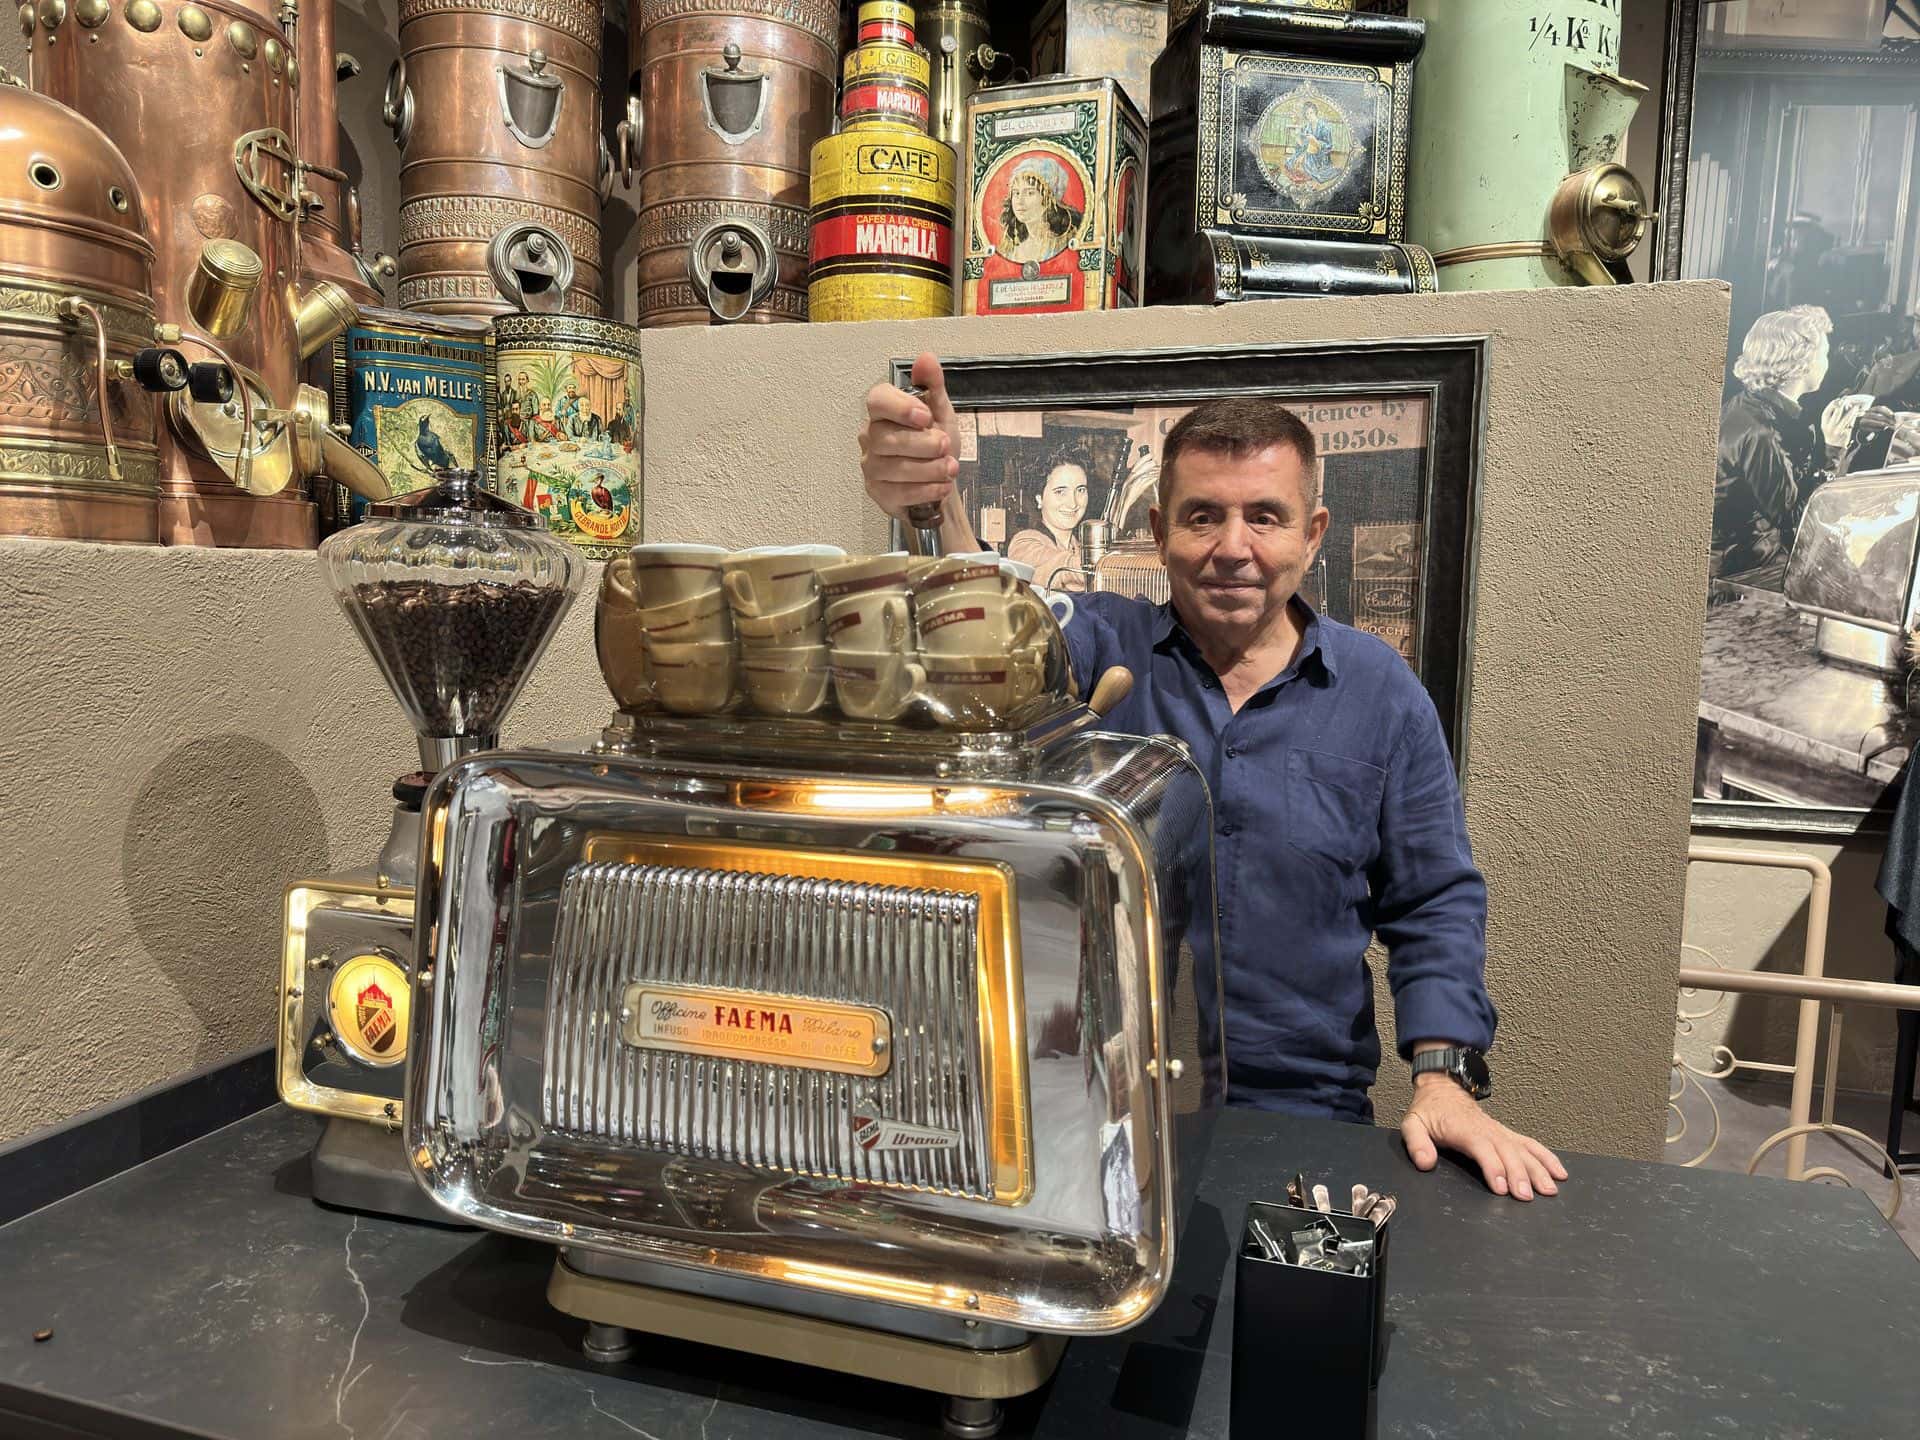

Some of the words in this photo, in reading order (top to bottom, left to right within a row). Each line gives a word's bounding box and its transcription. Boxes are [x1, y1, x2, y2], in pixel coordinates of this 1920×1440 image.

[870, 148, 930, 176] CAFE
[898, 216, 910, 225] LA
[856, 224, 938, 260] MARCILLA
[364, 371, 395, 392] N.V.
[1381, 400, 1407, 420] by
[1321, 428, 1399, 451] 1950s
[363, 1010, 391, 1044] FAEMA
[651, 1000, 707, 1021] Officine
[714, 1005, 792, 1034] FAEMA
[653, 1024, 689, 1036] INFUSO
